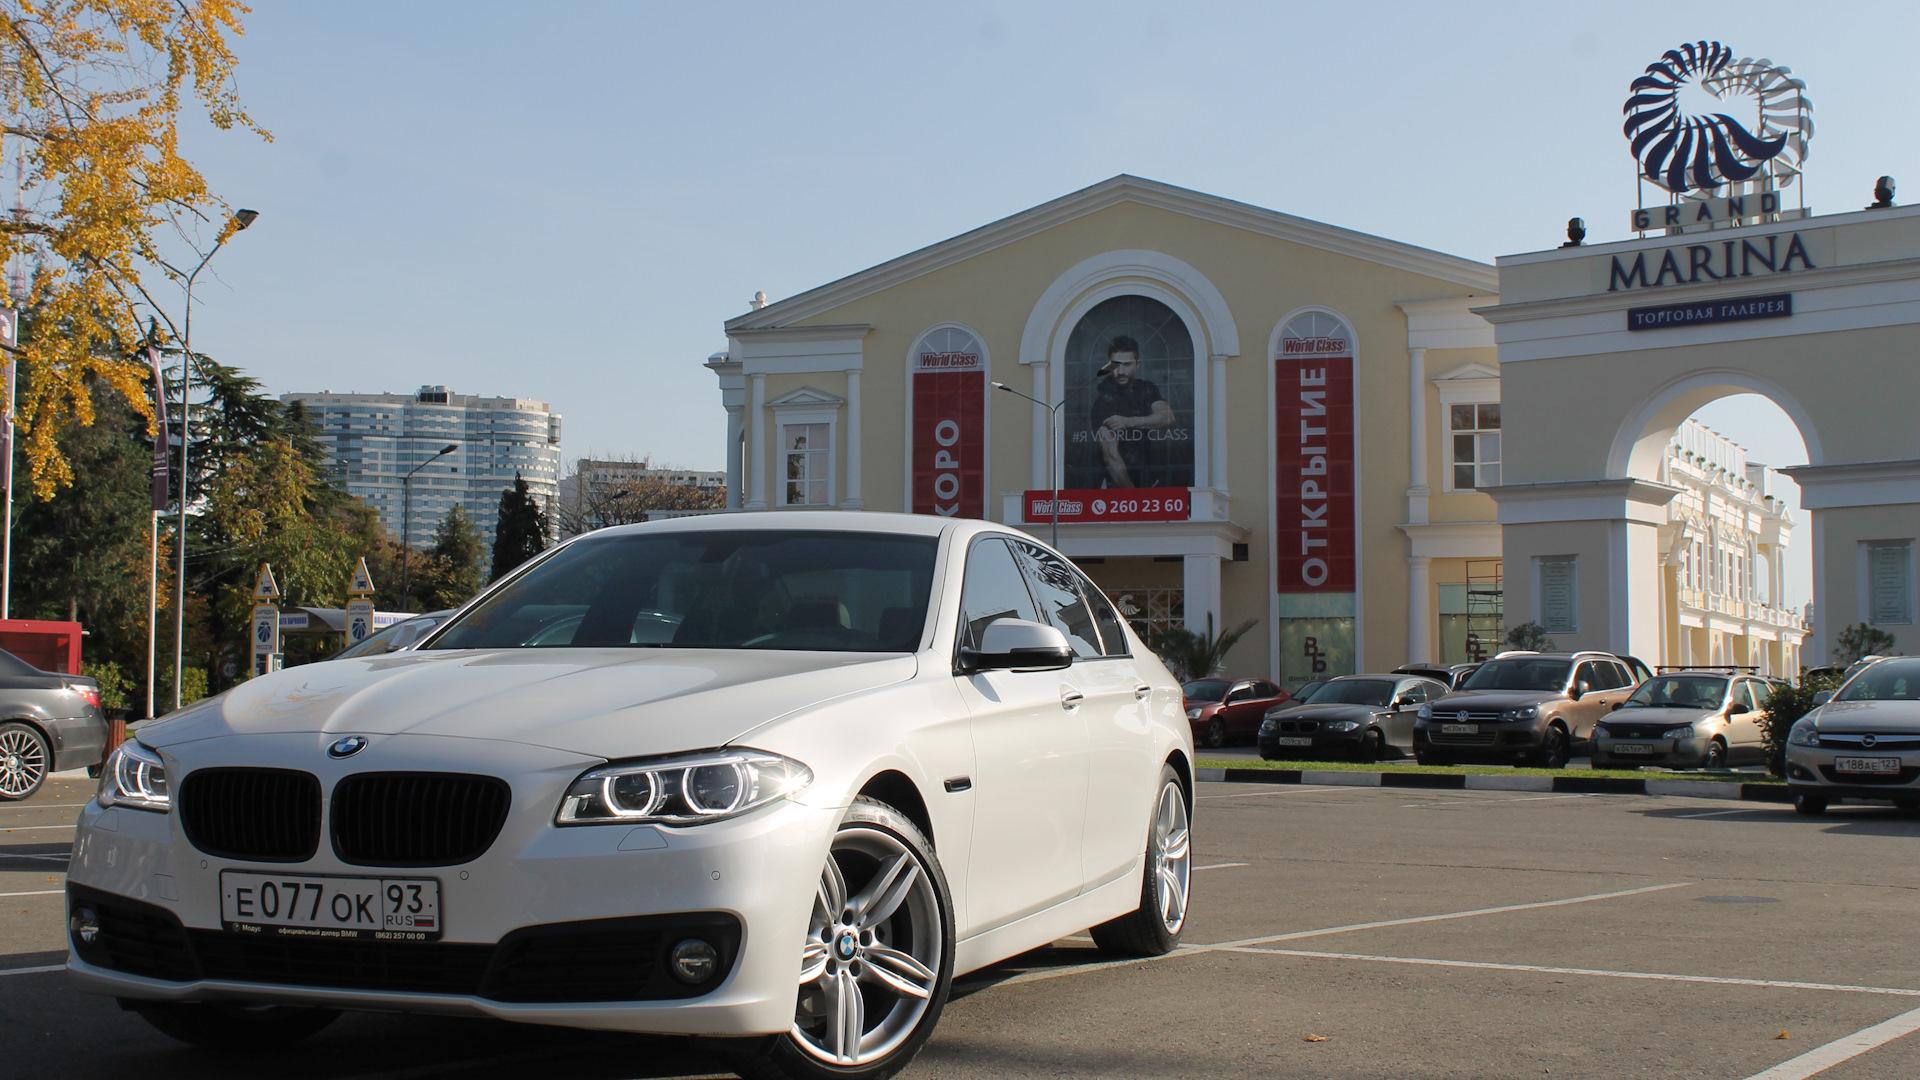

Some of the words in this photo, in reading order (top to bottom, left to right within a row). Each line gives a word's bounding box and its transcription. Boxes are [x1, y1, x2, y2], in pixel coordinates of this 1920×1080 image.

[1634, 193, 1777, 229] GRAND
[1607, 232, 1817, 292] MARINA
[1635, 307, 1713, 325] ТОРГОВАЯ
[1721, 300, 1785, 317] ГАЛЕРЕЯ
[1284, 339, 1314, 354] World
[1315, 338, 1345, 353] Class
[921, 353, 949, 368] World
[950, 352, 977, 367] Class
[1091, 429, 1143, 441] WORLD
[1147, 428, 1189, 441] CLASS
[1300, 367, 1328, 587] ОТКРЫТИЕ
[1034, 501, 1058, 514] Worl
[1059, 501, 1082, 514] Class
[1110, 500, 1138, 513] 260
[1142, 500, 1160, 512] 23
[1164, 499, 1183, 512] 60
[236, 881, 375, 923] Е077ОК
[386, 884, 423, 913] 93
[385, 915, 413, 926] RUS
[242, 924, 262, 933] Модус
[278, 927, 320, 936] официальный
[321, 929, 340, 937] дилер
[393, 932, 406, 940] 257
[406, 932, 415, 940] 00
